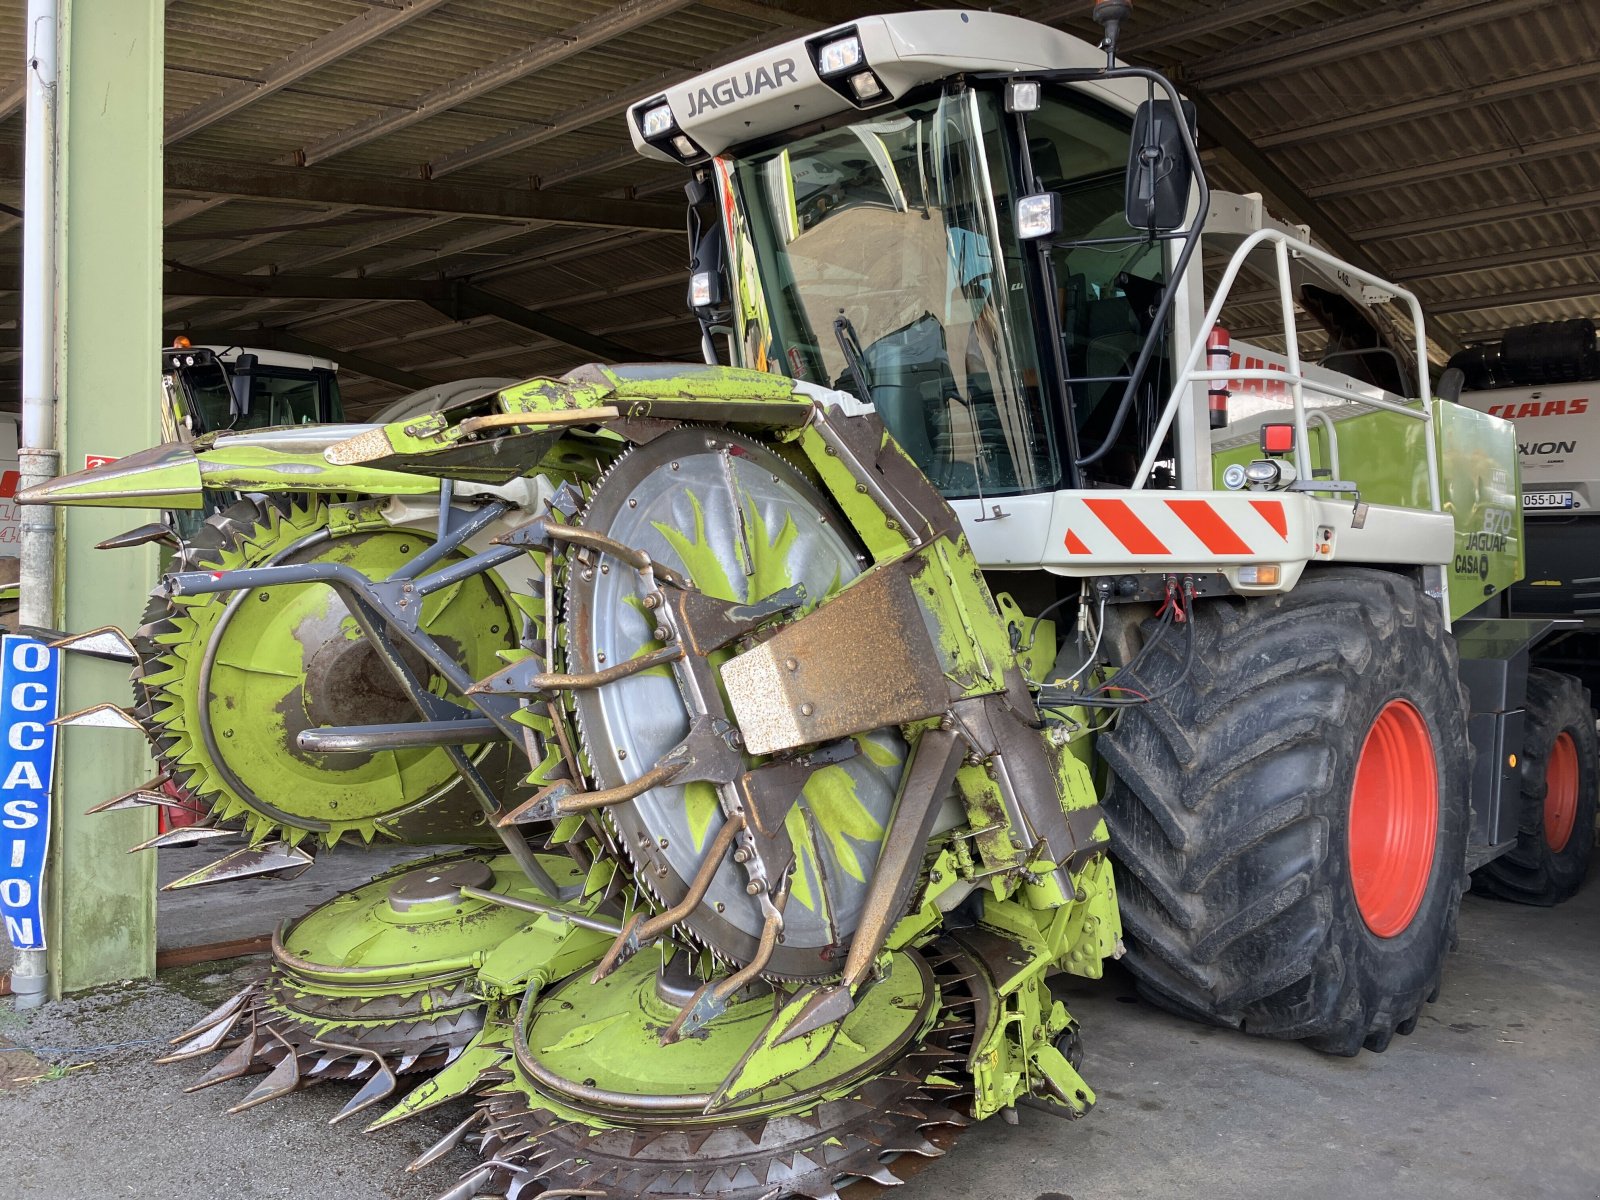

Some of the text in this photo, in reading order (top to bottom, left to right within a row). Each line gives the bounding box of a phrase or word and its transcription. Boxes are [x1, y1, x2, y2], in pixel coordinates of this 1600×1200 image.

[687, 58, 798, 118] JAGUAR
[1488, 399, 1589, 418] CLAAS
[1524, 494, 1564, 506] 055-DJ
[1484, 508, 1512, 535] 870
[1465, 532, 1508, 552] JAGUAR
[0, 642, 51, 945] OCCASION
